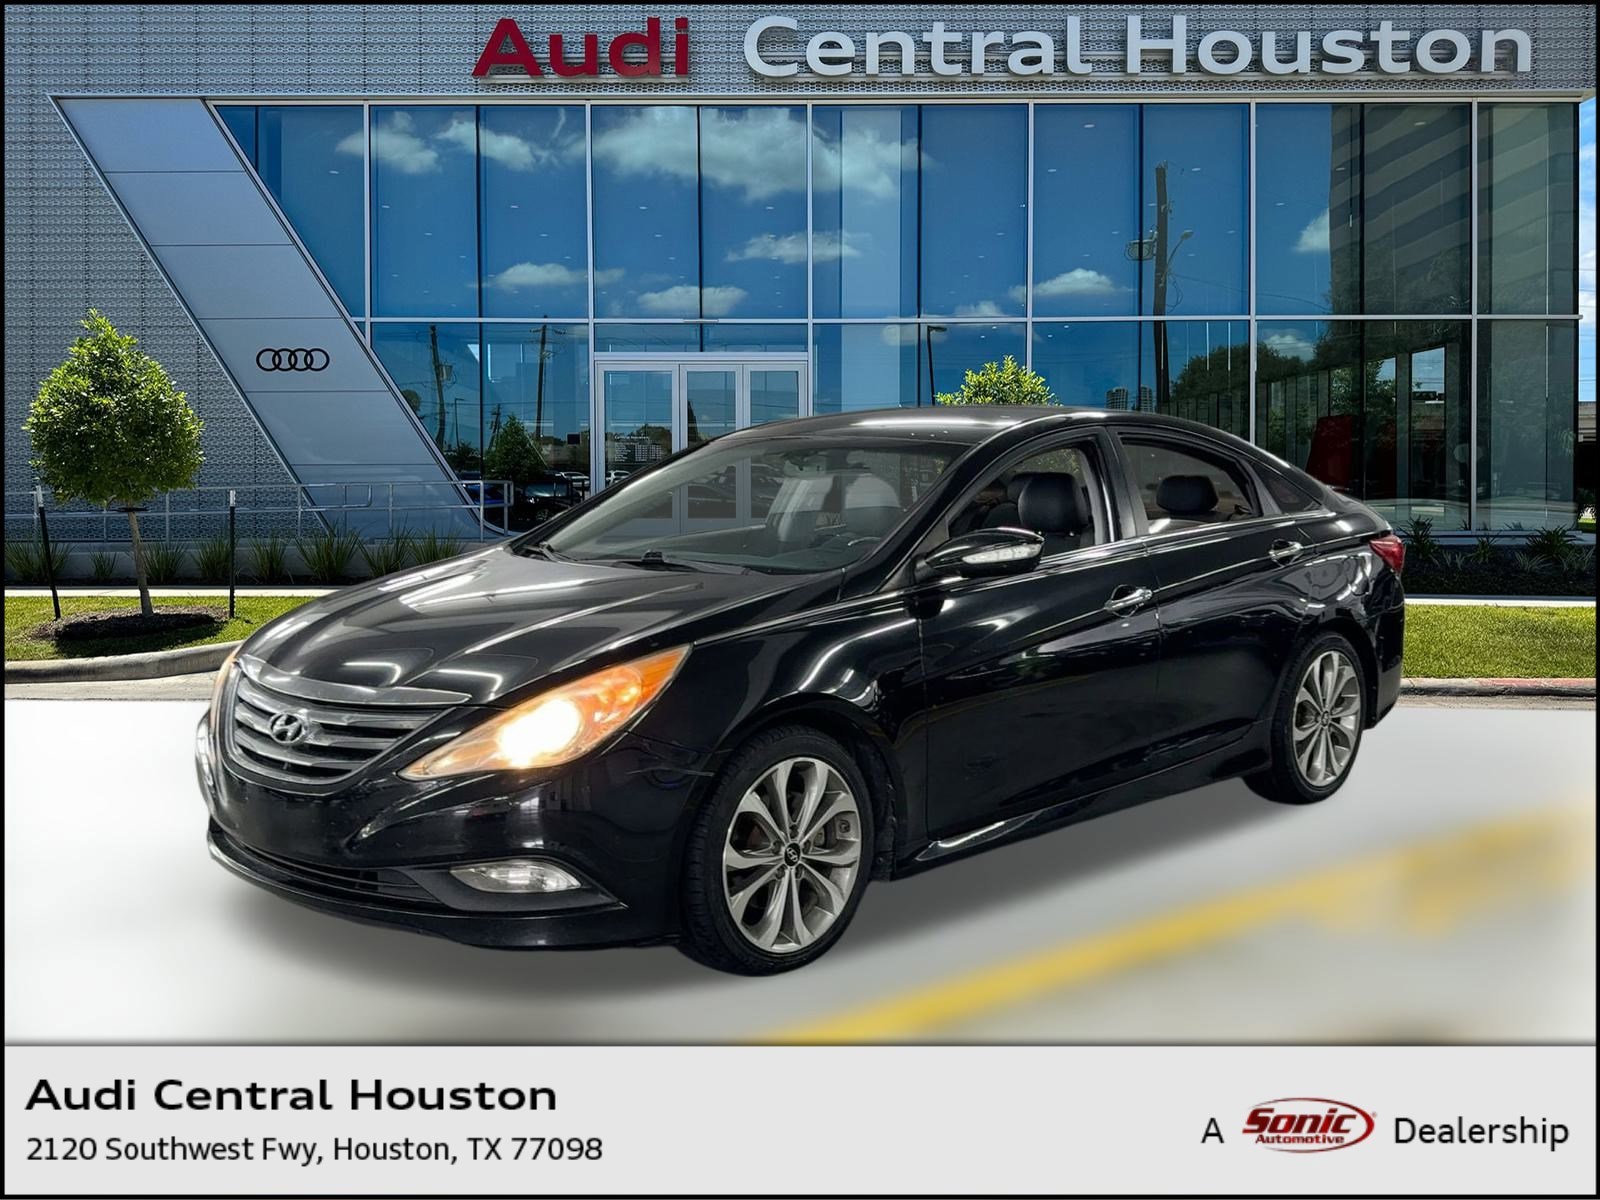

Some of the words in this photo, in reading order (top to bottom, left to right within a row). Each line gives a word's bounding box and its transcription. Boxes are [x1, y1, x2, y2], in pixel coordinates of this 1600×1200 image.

[472, 17, 690, 78] Audi
[743, 15, 1092, 77] Central
[1124, 14, 1532, 76] Houston
